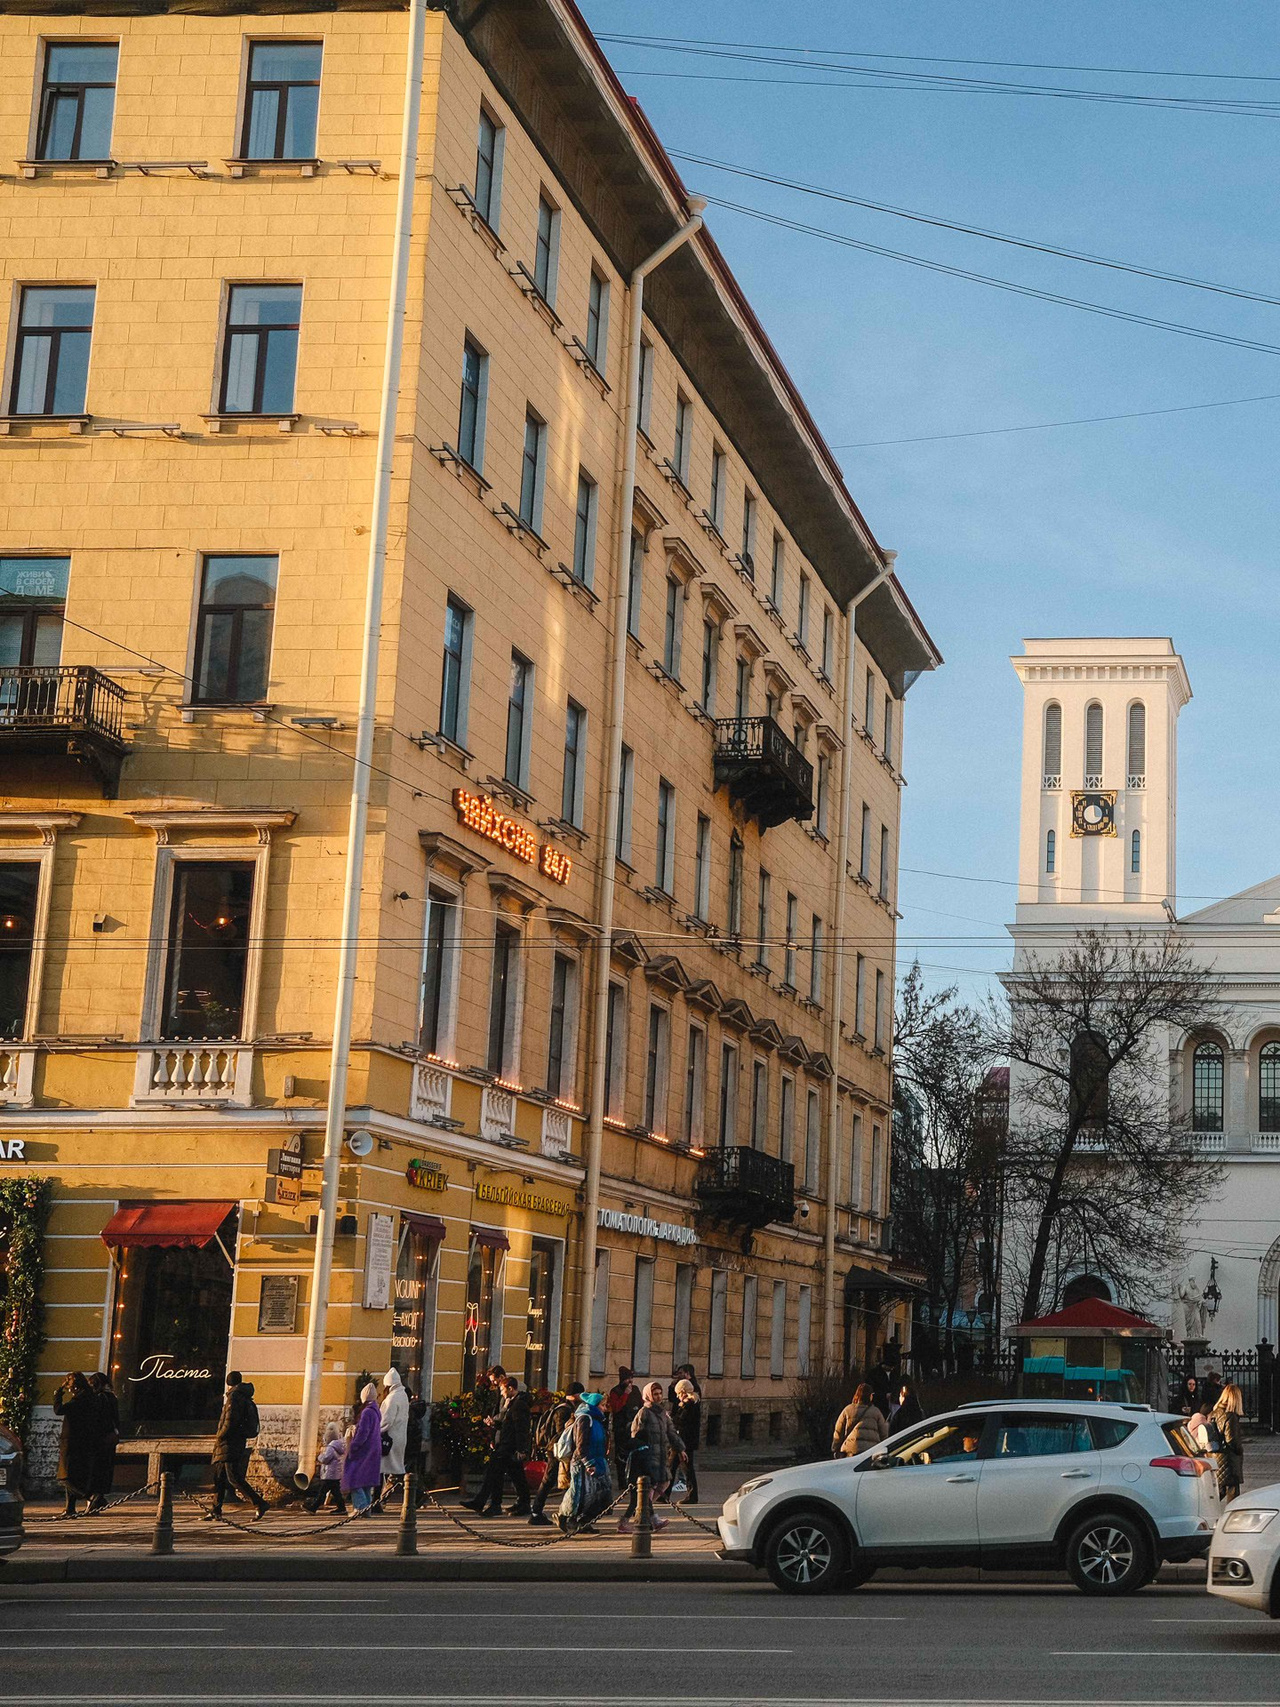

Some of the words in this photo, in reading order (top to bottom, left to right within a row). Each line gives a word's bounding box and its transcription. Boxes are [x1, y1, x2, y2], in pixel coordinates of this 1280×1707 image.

[15, 585, 54, 596] ДОМЕ
[457, 786, 536, 865] ЧАЙХОНА
[417, 1169, 450, 1192] KRIEK
[480, 1184, 533, 1209] БЕЛЬГИЙСКАЯ
[532, 1195, 571, 1217] БРАССЕРИЯ
[128, 1354, 212, 1382] Паста
